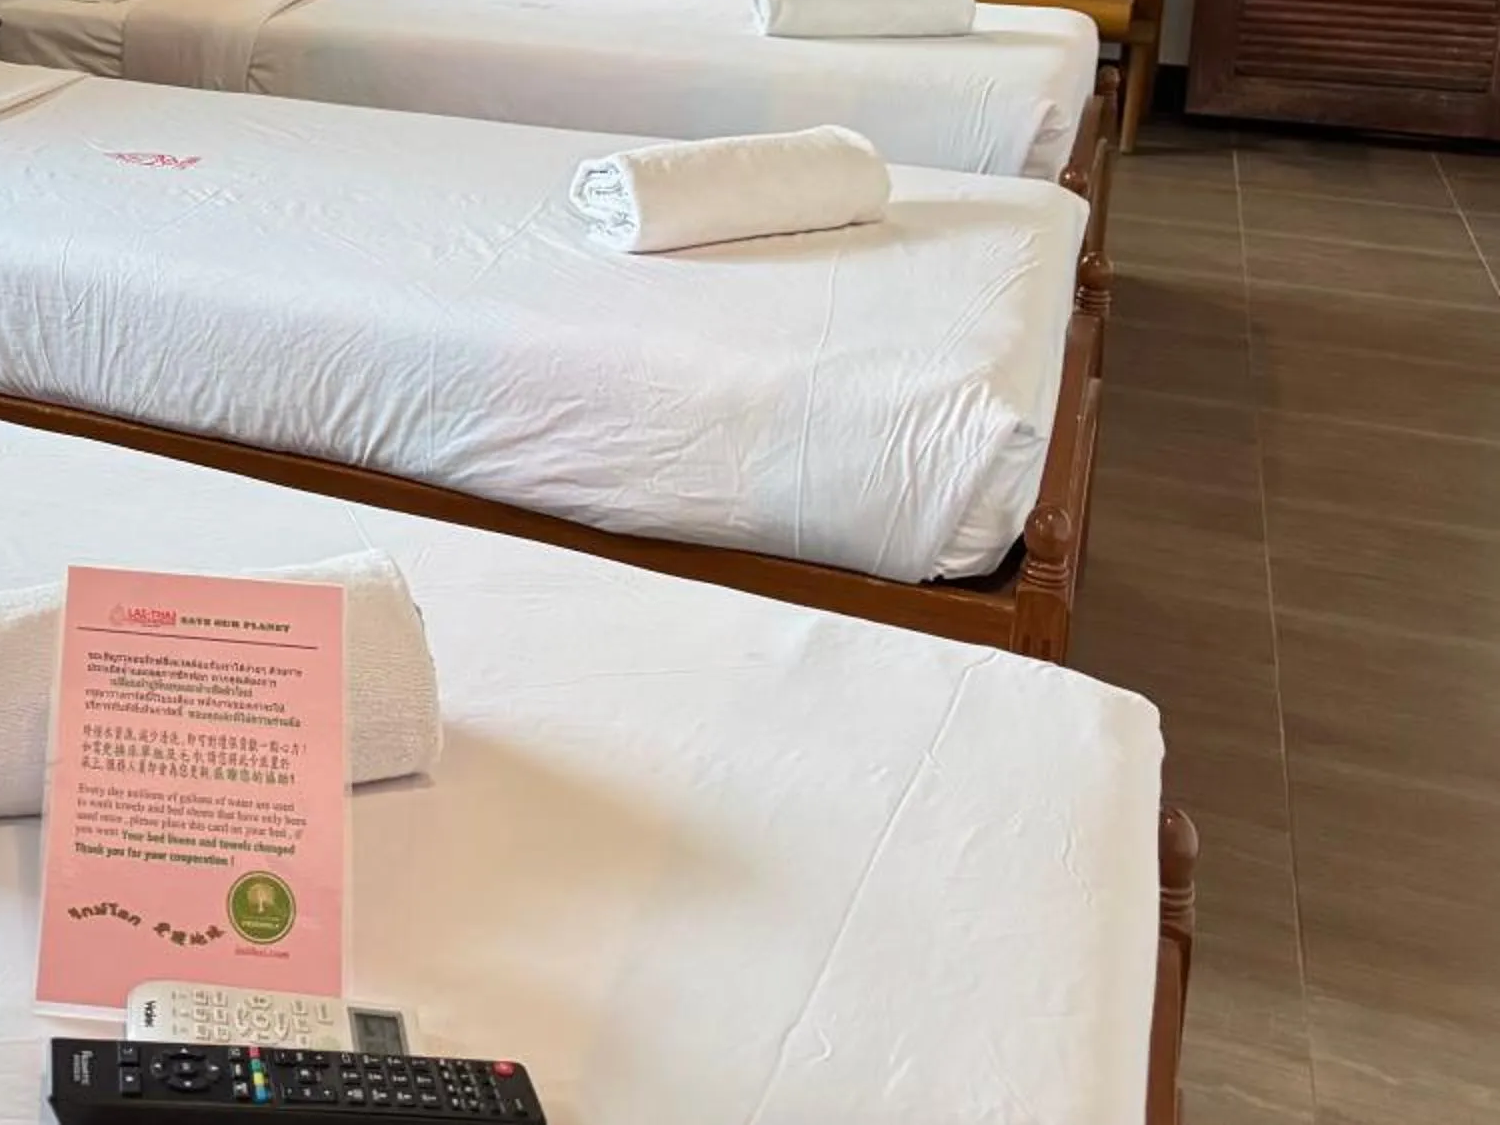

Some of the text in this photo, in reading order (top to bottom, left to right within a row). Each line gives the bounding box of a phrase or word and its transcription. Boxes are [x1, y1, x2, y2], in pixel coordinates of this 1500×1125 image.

[243, 620, 291, 633] PLANET
[77, 783, 103, 796] Every
[107, 786, 123, 796] day
[166, 792, 177, 801] of
[215, 797, 226, 805] of
[147, 803, 164, 813] and
[166, 805, 183, 815] bed
[237, 812, 258, 821] have
[261, 813, 281, 825] only
[161, 817, 186, 830] place
[207, 822, 228, 832] card
[244, 827, 266, 838] your
[74, 842, 103, 854] Thank
[106, 846, 124, 857] you
[127, 847, 142, 858] for
[143, 850, 167, 861] your
[121, 830, 144, 841] Your
[146, 832, 164, 843] bed
[198, 837, 215, 847] and
[218, 839, 251, 850] towels
[253, 841, 295, 857] changed
